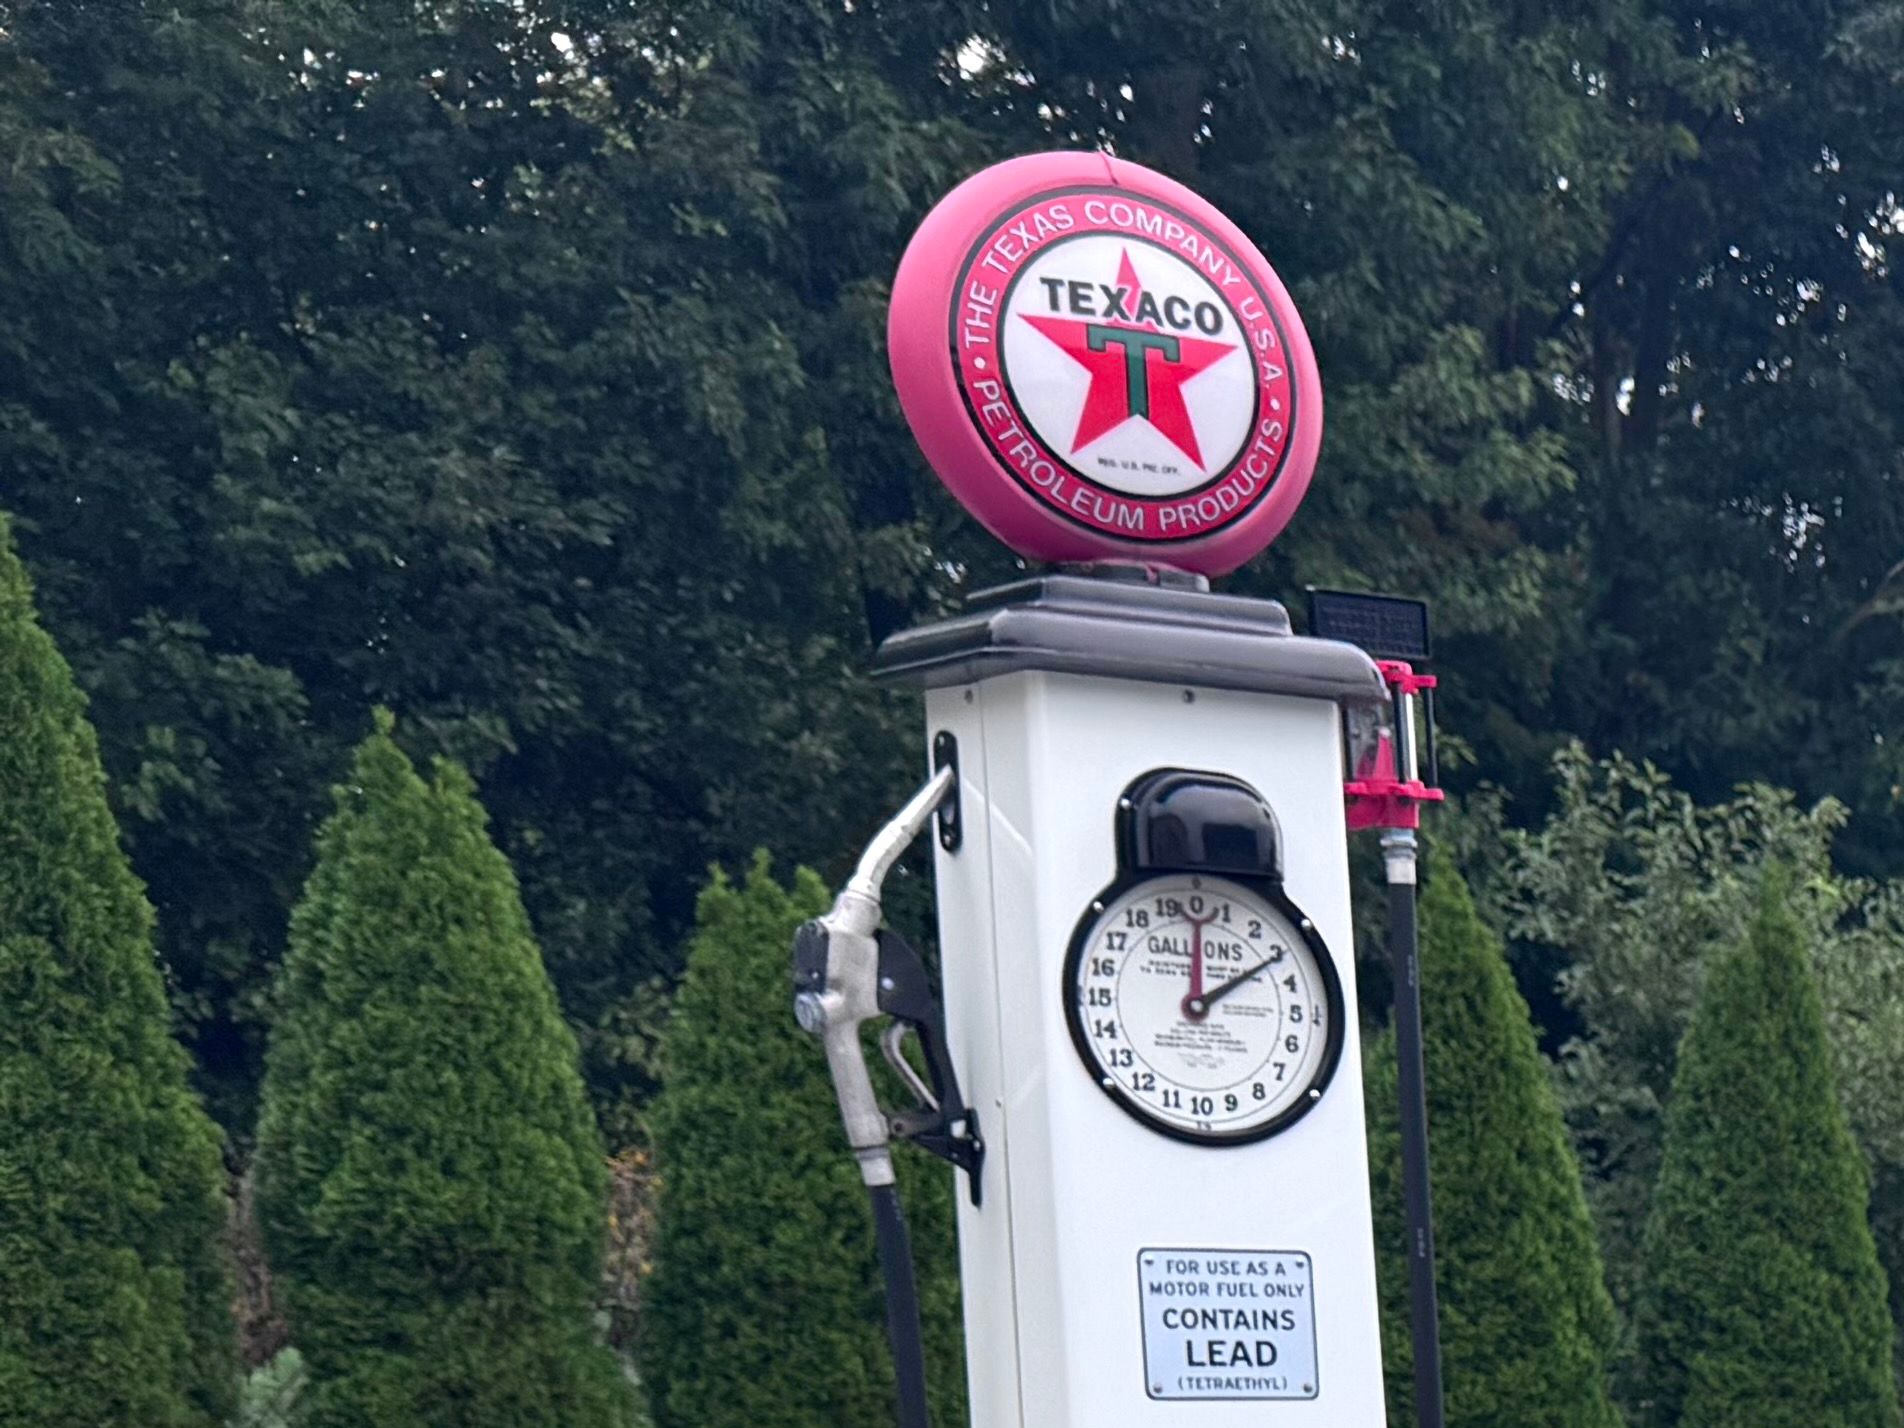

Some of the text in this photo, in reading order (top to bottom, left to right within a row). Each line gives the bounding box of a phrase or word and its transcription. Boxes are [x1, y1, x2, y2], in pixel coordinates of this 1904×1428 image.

[965, 281, 998, 346] THE
[984, 204, 1074, 274] TEXAS
[1084, 200, 1241, 287] COMPANY
[1040, 277, 1224, 335] TEXACO
[973, 379, 1283, 531] PETROLEUM PRODUCTS
[1156, 897, 1178, 917] 19
[1189, 897, 1204, 914] 0
[1221, 906, 1231, 923] 1
[1126, 910, 1149, 929] 18
[1248, 920, 1262, 939] 2
[1107, 934, 1128, 952] 17
[1148, 935, 1243, 962] GALLONS
[1092, 959, 1116, 977] 16
[1283, 975, 1297, 994] 4
[1089, 988, 1112, 1006] 15
[1289, 1005, 1303, 1023] 5
[1093, 1021, 1116, 1039] 14
[1286, 1035, 1299, 1053] 6
[1110, 1049, 1134, 1068] 13
[1273, 1063, 1286, 1080] 7
[1133, 1073, 1156, 1091] 12
[1253, 1082, 1266, 1100] 8
[1162, 1090, 1182, 1108] 11
[1191, 1097, 1213, 1115] 10
[1225, 1093, 1239, 1111] 9
[1166, 1259, 1287, 1277] FOR USE AS A
[1149, 1281, 1306, 1298] MOTOR FUEL ONLY
[1162, 1307, 1297, 1331] CONTAINS
[1186, 1339, 1279, 1368] LEAD
[1177, 1376, 1288, 1391] (TETRAETHYL)
